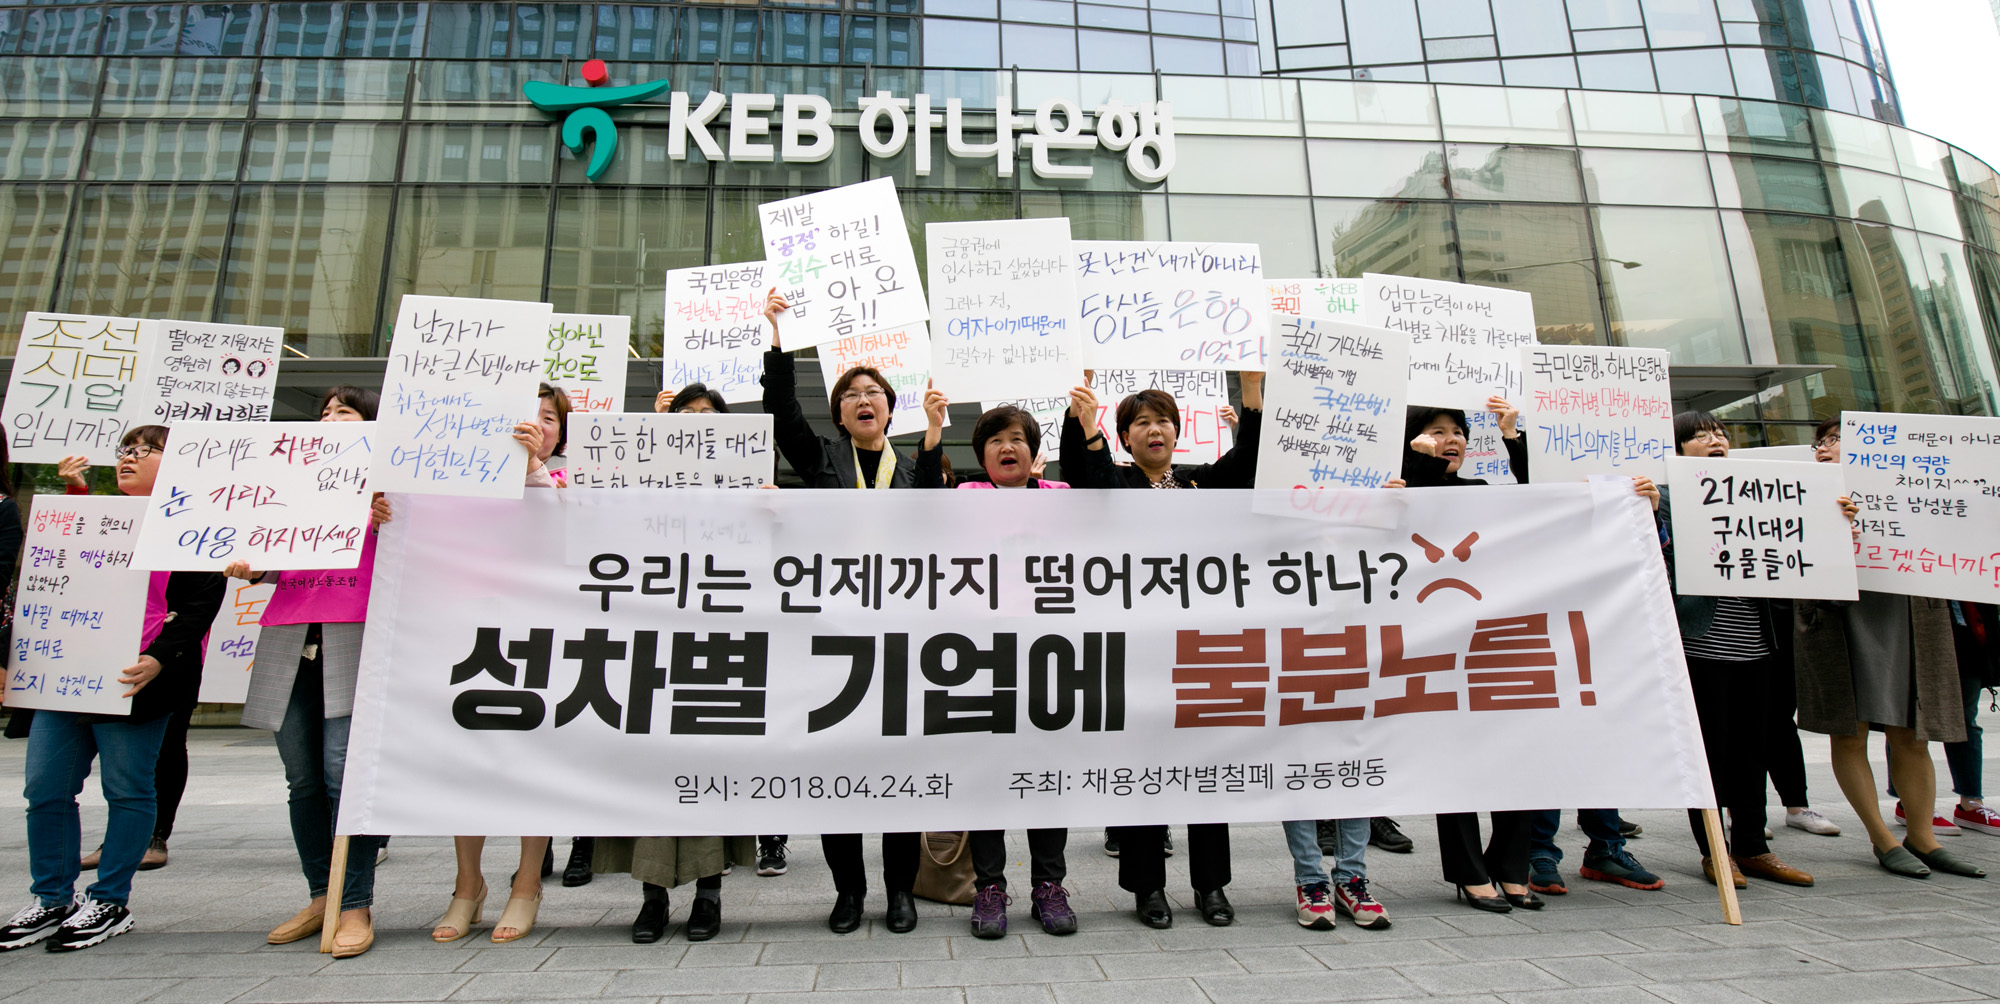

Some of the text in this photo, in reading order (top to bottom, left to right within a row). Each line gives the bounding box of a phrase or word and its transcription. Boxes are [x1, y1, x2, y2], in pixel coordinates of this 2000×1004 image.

[667, 89, 1176, 184] KEB 하나은행
[768, 201, 814, 228] 제발
[828, 214, 880, 241] 하길!
[941, 237, 1001, 259] 금융권에
[777, 245, 881, 286] 점수 대로
[941, 255, 1068, 284] 입사하고 싶었습니다
[1159, 252, 1196, 272] 내가
[1202, 254, 1260, 274] 아니라
[687, 266, 764, 295] 국민은행
[1284, 284, 1301, 295] KB
[1332, 283, 1358, 294] KEB
[674, 298, 723, 322] 절반만
[944, 292, 1011, 310] 그러나 전,
[1271, 297, 1300, 315] 국민
[1326, 296, 1360, 314] 하나
[1379, 284, 1493, 317] 업무능력이 아닌
[413, 309, 505, 346] 남자가
[828, 299, 877, 336] 좀!!
[1081, 289, 1252, 344] 당신들 은행
[27, 318, 140, 354] 조선
[168, 328, 275, 354] 떨어진 지원자는
[684, 324, 761, 350] 하나은행
[1281, 324, 1384, 360] 국민 기만하는
[1435, 320, 1477, 345] 채용을
[163, 355, 211, 373] 영원히
[1003, 344, 1069, 365] 없나봅니다.
[1180, 336, 1268, 365] 이었다
[23, 351, 138, 382] 시대
[670, 359, 715, 387] 하나도
[1283, 359, 1357, 386] 성차별주의 기업
[1532, 352, 1604, 382] 국민은행,
[20, 382, 126, 412] 기업
[155, 376, 270, 400] 떨어지지 않는다
[1090, 370, 1224, 398] 여성을 차별하면!
[391, 383, 482, 417] 취준에서도
[1313, 386, 1391, 416] 국민은행!
[1534, 388, 1600, 417] 채용차별
[1632, 394, 1671, 419] 사죄하고
[1276, 408, 1378, 443] 남성만 하나 되는
[1908, 432, 1953, 447] 때문이
[178, 432, 340, 471] 이래도 차별이
[583, 425, 766, 463] 유능한 여자들 대신
[1277, 435, 1357, 463] 성차별주의 기업
[1624, 425, 1673, 462] 보여라
[1309, 459, 1391, 489] 하나은행!
[1847, 453, 1951, 476] 개인의 역량
[160, 484, 288, 517] 눈 가리고
[1700, 476, 1806, 505] 21세기다
[1850, 491, 1968, 518] 수많은 남성분들
[34, 510, 134, 536] 성차별을 했으니
[1712, 516, 1804, 546] 구시대의
[1852, 519, 1906, 537] 아직도
[178, 526, 236, 558] 아웅
[30, 546, 134, 569] 결과를 예상하지
[1714, 548, 1814, 581] 유물들아
[26, 575, 70, 595] 않았나?
[579, 549, 1410, 615] 우리는 언제까지 떨어져야 하나?
[22, 604, 104, 630] 바뀔 때까진
[11, 669, 104, 696] 쓰지 않겠다
[449, 610, 1598, 737] 성차별 기업에 불분노를!
[673, 757, 1388, 805] 일시: 2018.04.24.화 주최: 채용성차별철폐 공동행동
